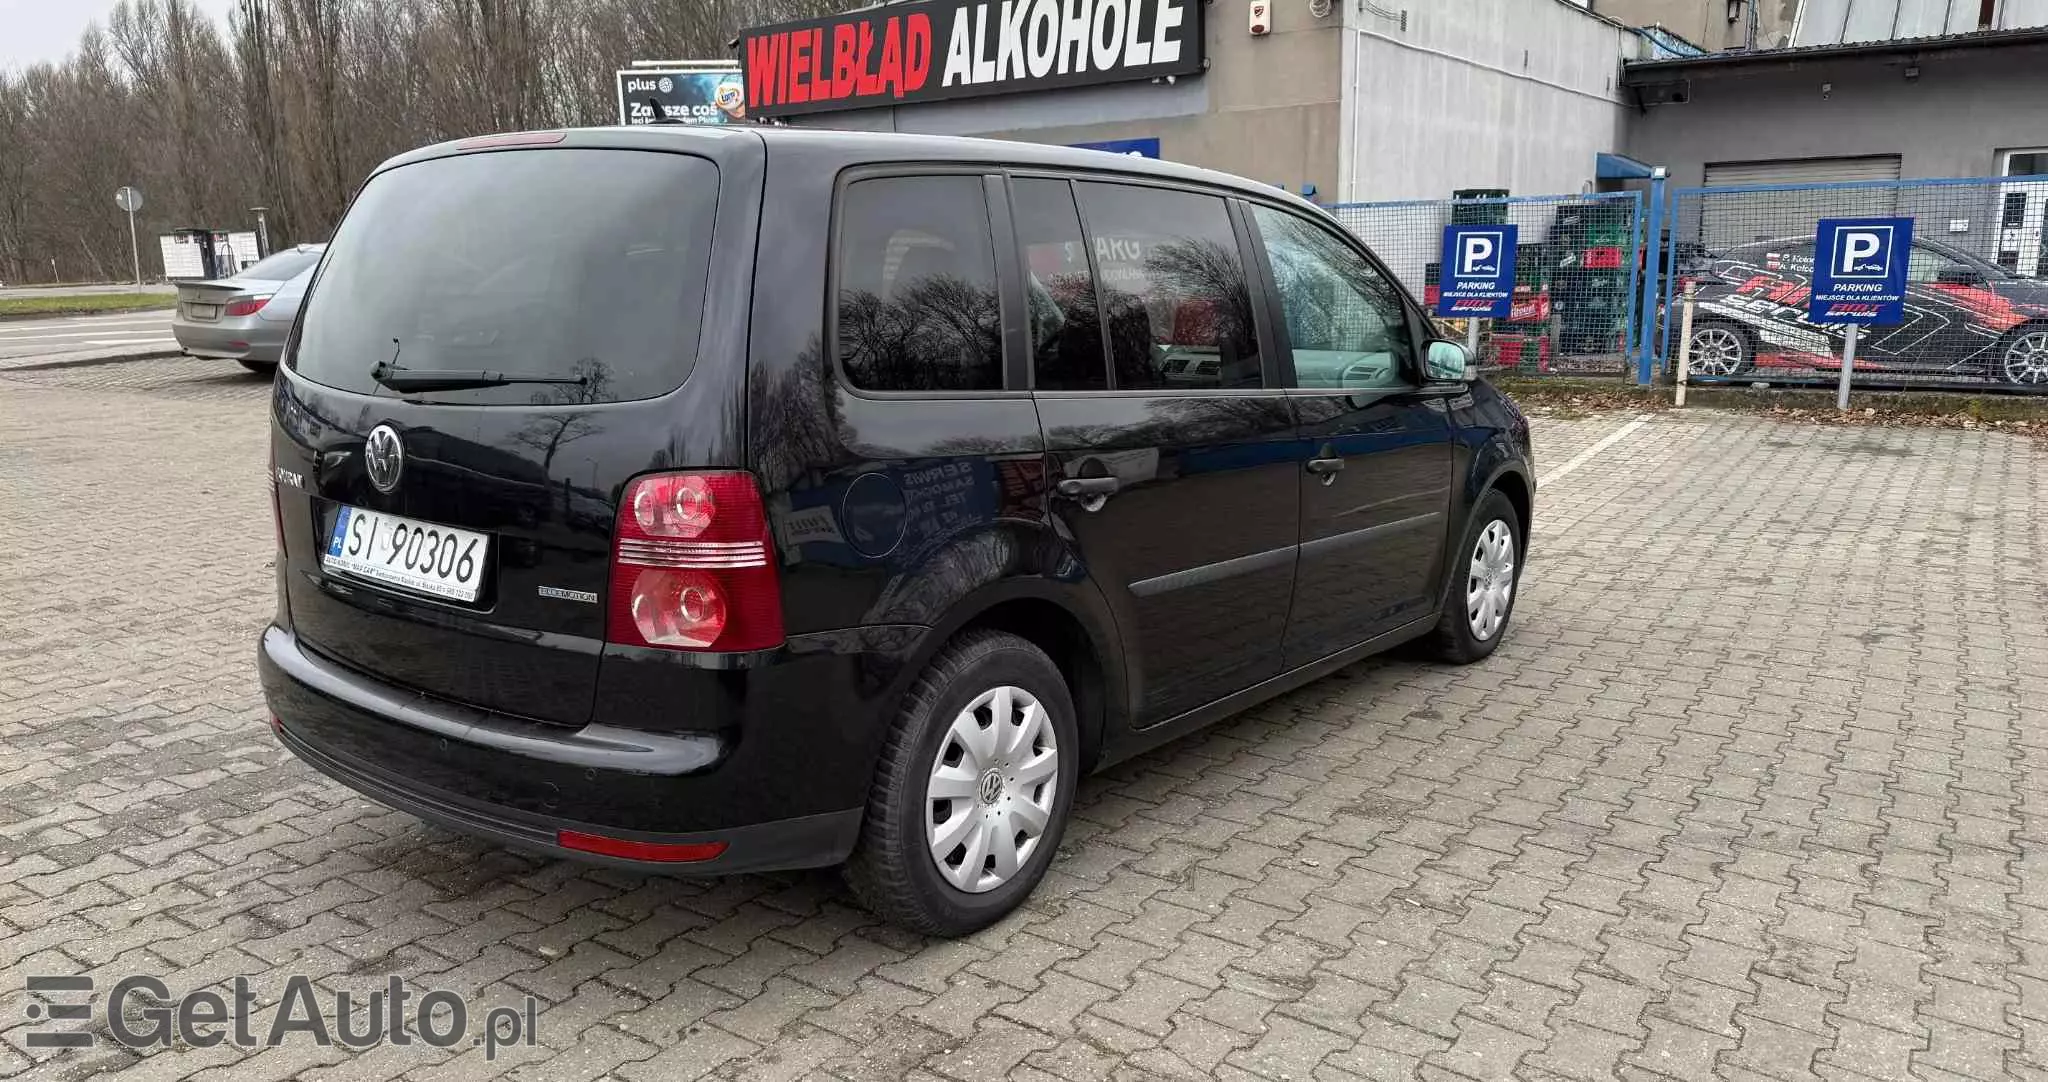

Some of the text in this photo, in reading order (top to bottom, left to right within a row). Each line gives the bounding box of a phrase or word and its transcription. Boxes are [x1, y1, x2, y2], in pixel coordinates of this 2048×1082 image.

[747, 0, 1184, 108] WIELBŁĄD ALKOHOLE
[627, 77, 656, 94] plus
[1464, 237, 1493, 273] P
[1843, 233, 1880, 273] P
[1456, 281, 1496, 290] PARKING
[1833, 283, 1884, 292] PARKING
[1861, 293, 1900, 301] KLIENTÓW
[333, 536, 342, 549] PL
[349, 513, 479, 583] SI 90306
